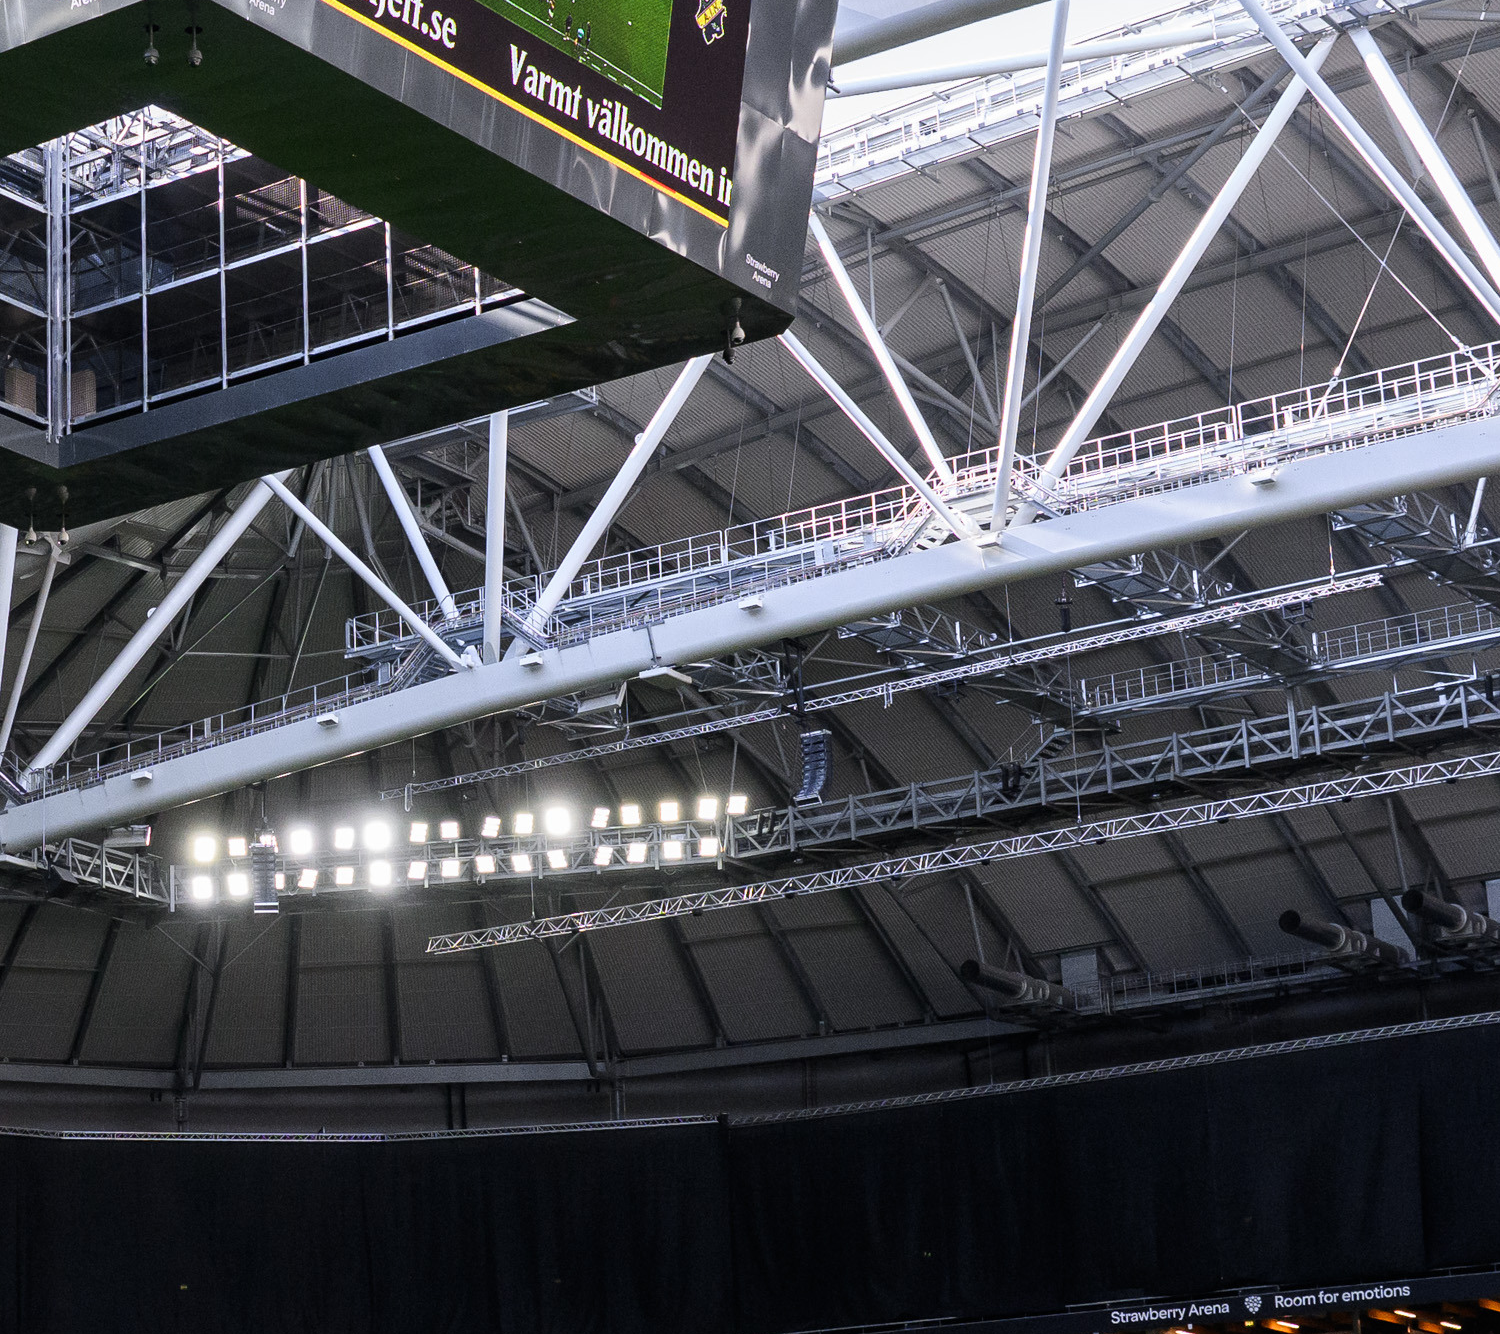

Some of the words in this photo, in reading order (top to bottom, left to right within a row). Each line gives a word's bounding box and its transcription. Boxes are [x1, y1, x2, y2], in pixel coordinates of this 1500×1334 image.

[510, 44, 582, 120] Varmt
[586, 99, 714, 197] välkommen
[745, 253, 781, 283] Strawberry
[752, 270, 773, 289] Arena
[1274, 1293, 1318, 1310] Room
[1318, 1292, 1340, 1307] for
[1341, 1284, 1412, 1305] emotions
[1110, 1307, 1189, 1326] Strawberry
[1188, 1301, 1231, 1319] Arena
